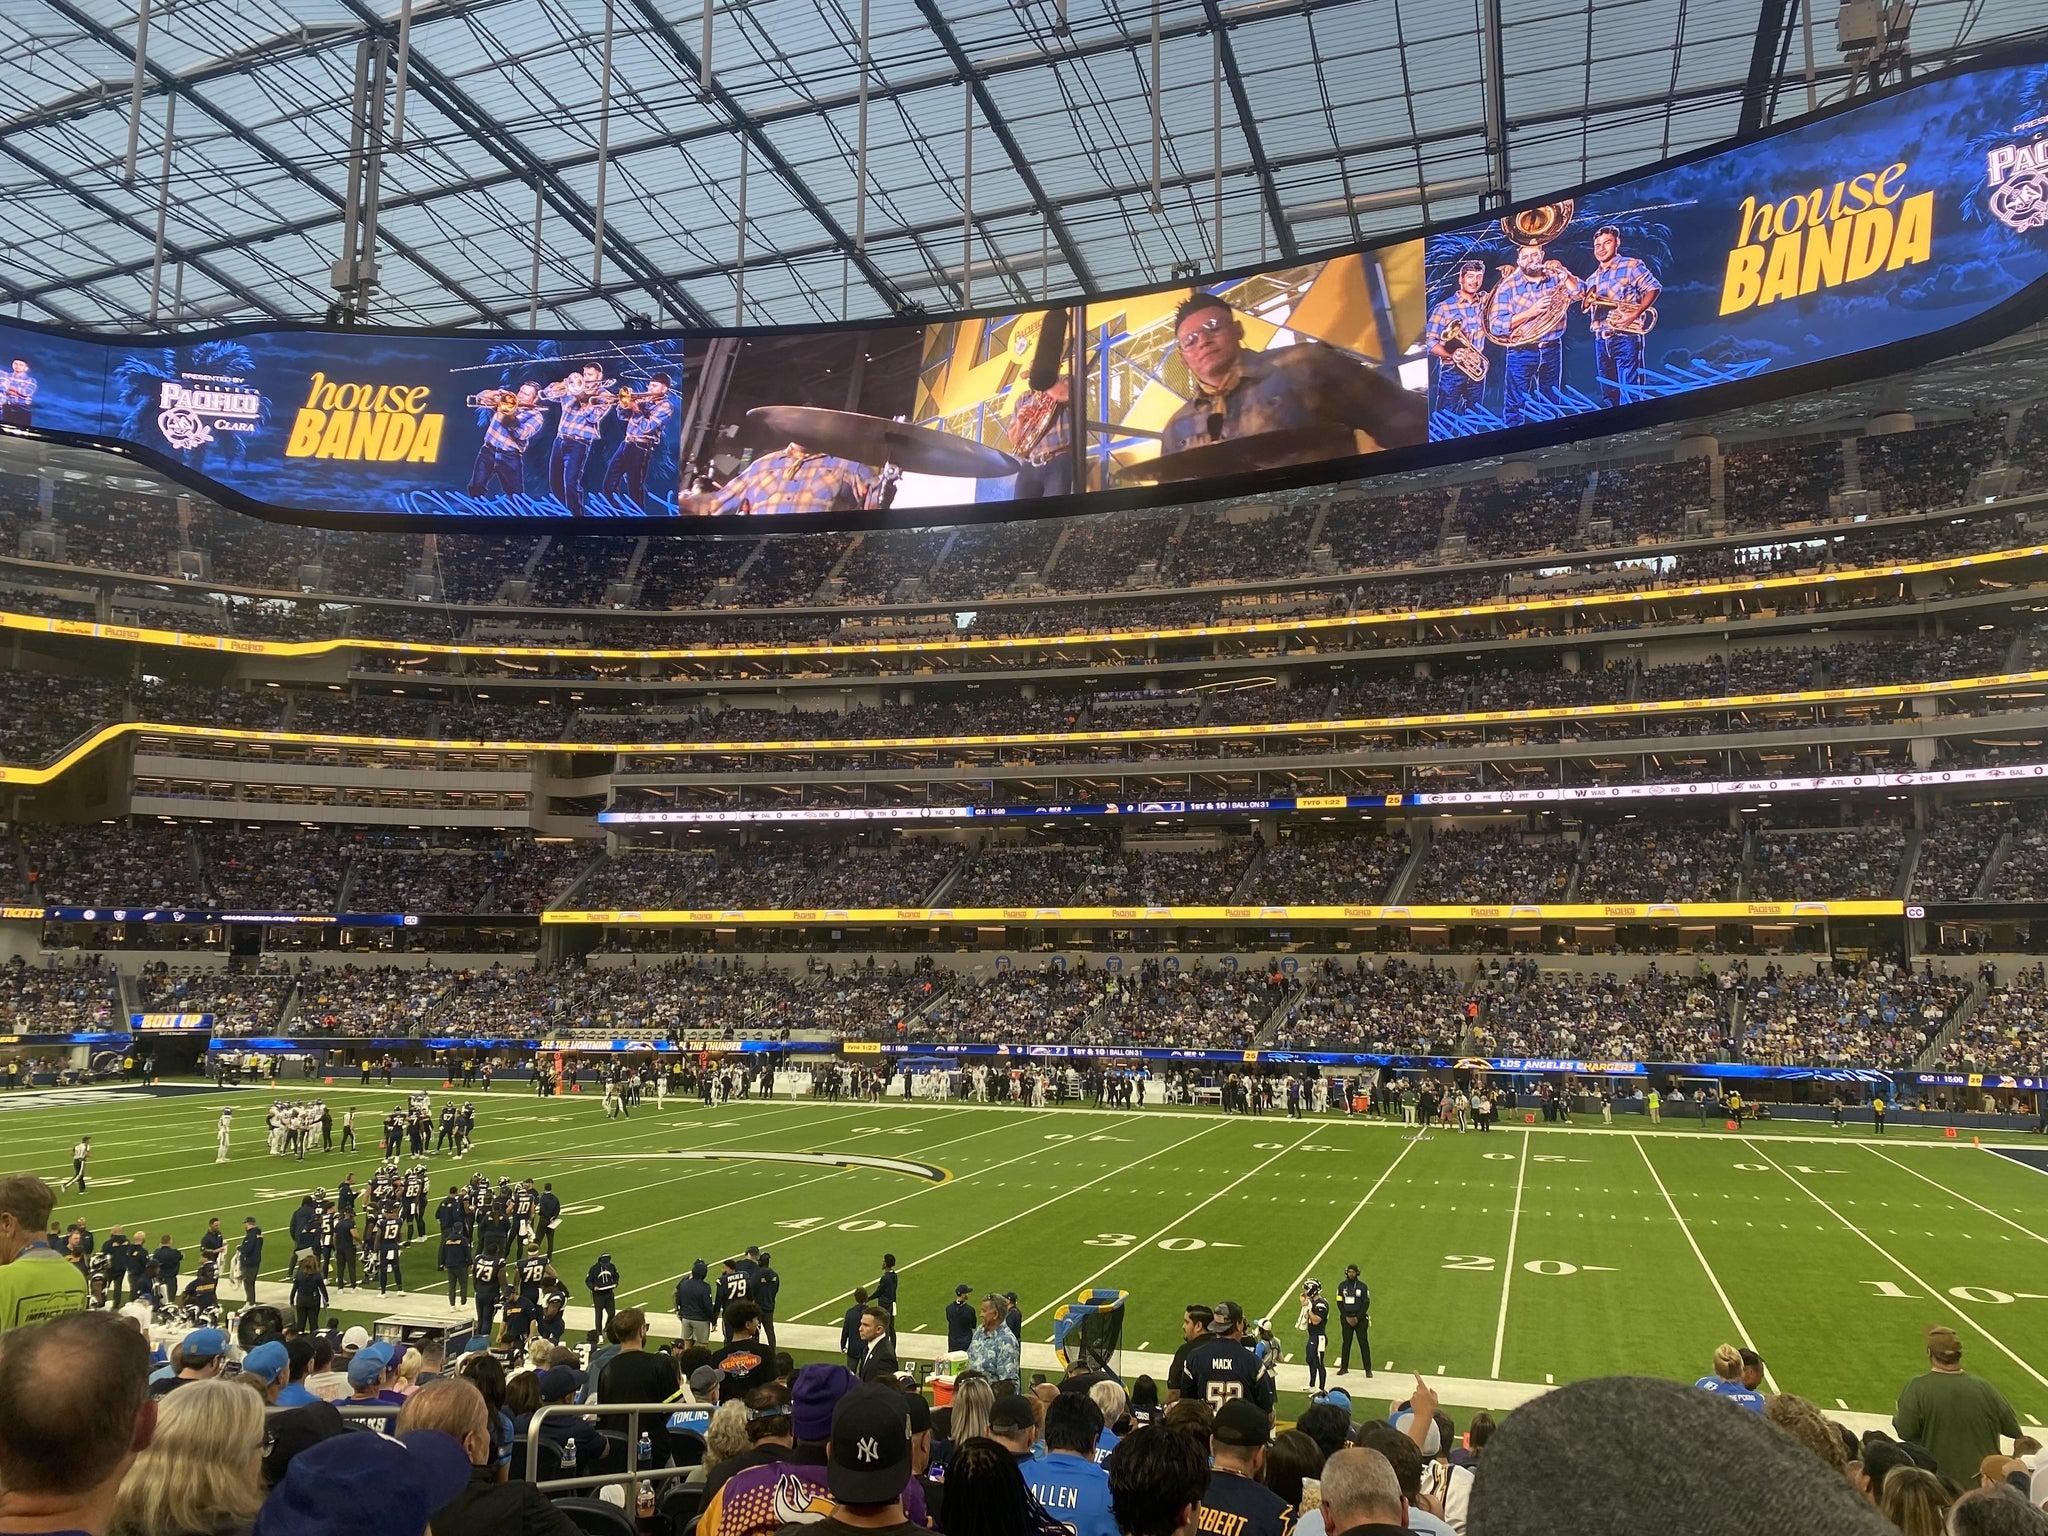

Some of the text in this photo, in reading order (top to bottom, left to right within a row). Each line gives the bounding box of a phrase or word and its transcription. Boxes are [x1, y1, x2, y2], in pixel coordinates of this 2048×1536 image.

[1738, 162, 1907, 247] house
[1718, 190, 1934, 316] BANDA
[181, 372, 230, 382] PRESENTED
[194, 384, 260, 395] CERVEZA
[311, 371, 431, 414] house
[159, 382, 259, 414] PACIFICO
[214, 419, 255, 432] CLARA
[285, 408, 445, 463] BANDA
[1942, 773, 1950, 781] 0
[2034, 766, 2043, 775] 0
[1612, 788, 1620, 796] 0
[1689, 784, 1697, 793] 0
[1770, 782, 1778, 790] 0
[1854, 778, 1862, 786] 0
[1388, 796, 1400, 804] 25
[1464, 794, 1472, 802] 0
[1537, 791, 1545, 799] 0
[1214, 802, 1227, 810] 10
[2, 907, 45, 919] TICKETS
[1909, 907, 1923, 917] CC
[405, 916, 416, 924] CC
[142, 1014, 202, 1028] BOLT UP
[540, 1040, 613, 1050] SEE THE LIGHTNING
[689, 1042, 743, 1051] THE THUNDER
[1245, 1052, 1256, 1060] 25
[1500, 1060, 1637, 1072] LOS ANGELES CHARGERS
[1920, 1074, 1934, 1082] Q2
[1944, 1076, 1964, 1084] 15:00
[406, 1185, 420, 1197] 83
[516, 1202, 531, 1214] 10
[384, 1224, 399, 1239] 13
[476, 1264, 493, 1282] 73
[523, 1266, 544, 1283] 78
[728, 1279, 747, 1300] 79
[1212, 1358, 1233, 1371] MACK
[856, 1436, 880, 1463] NY
